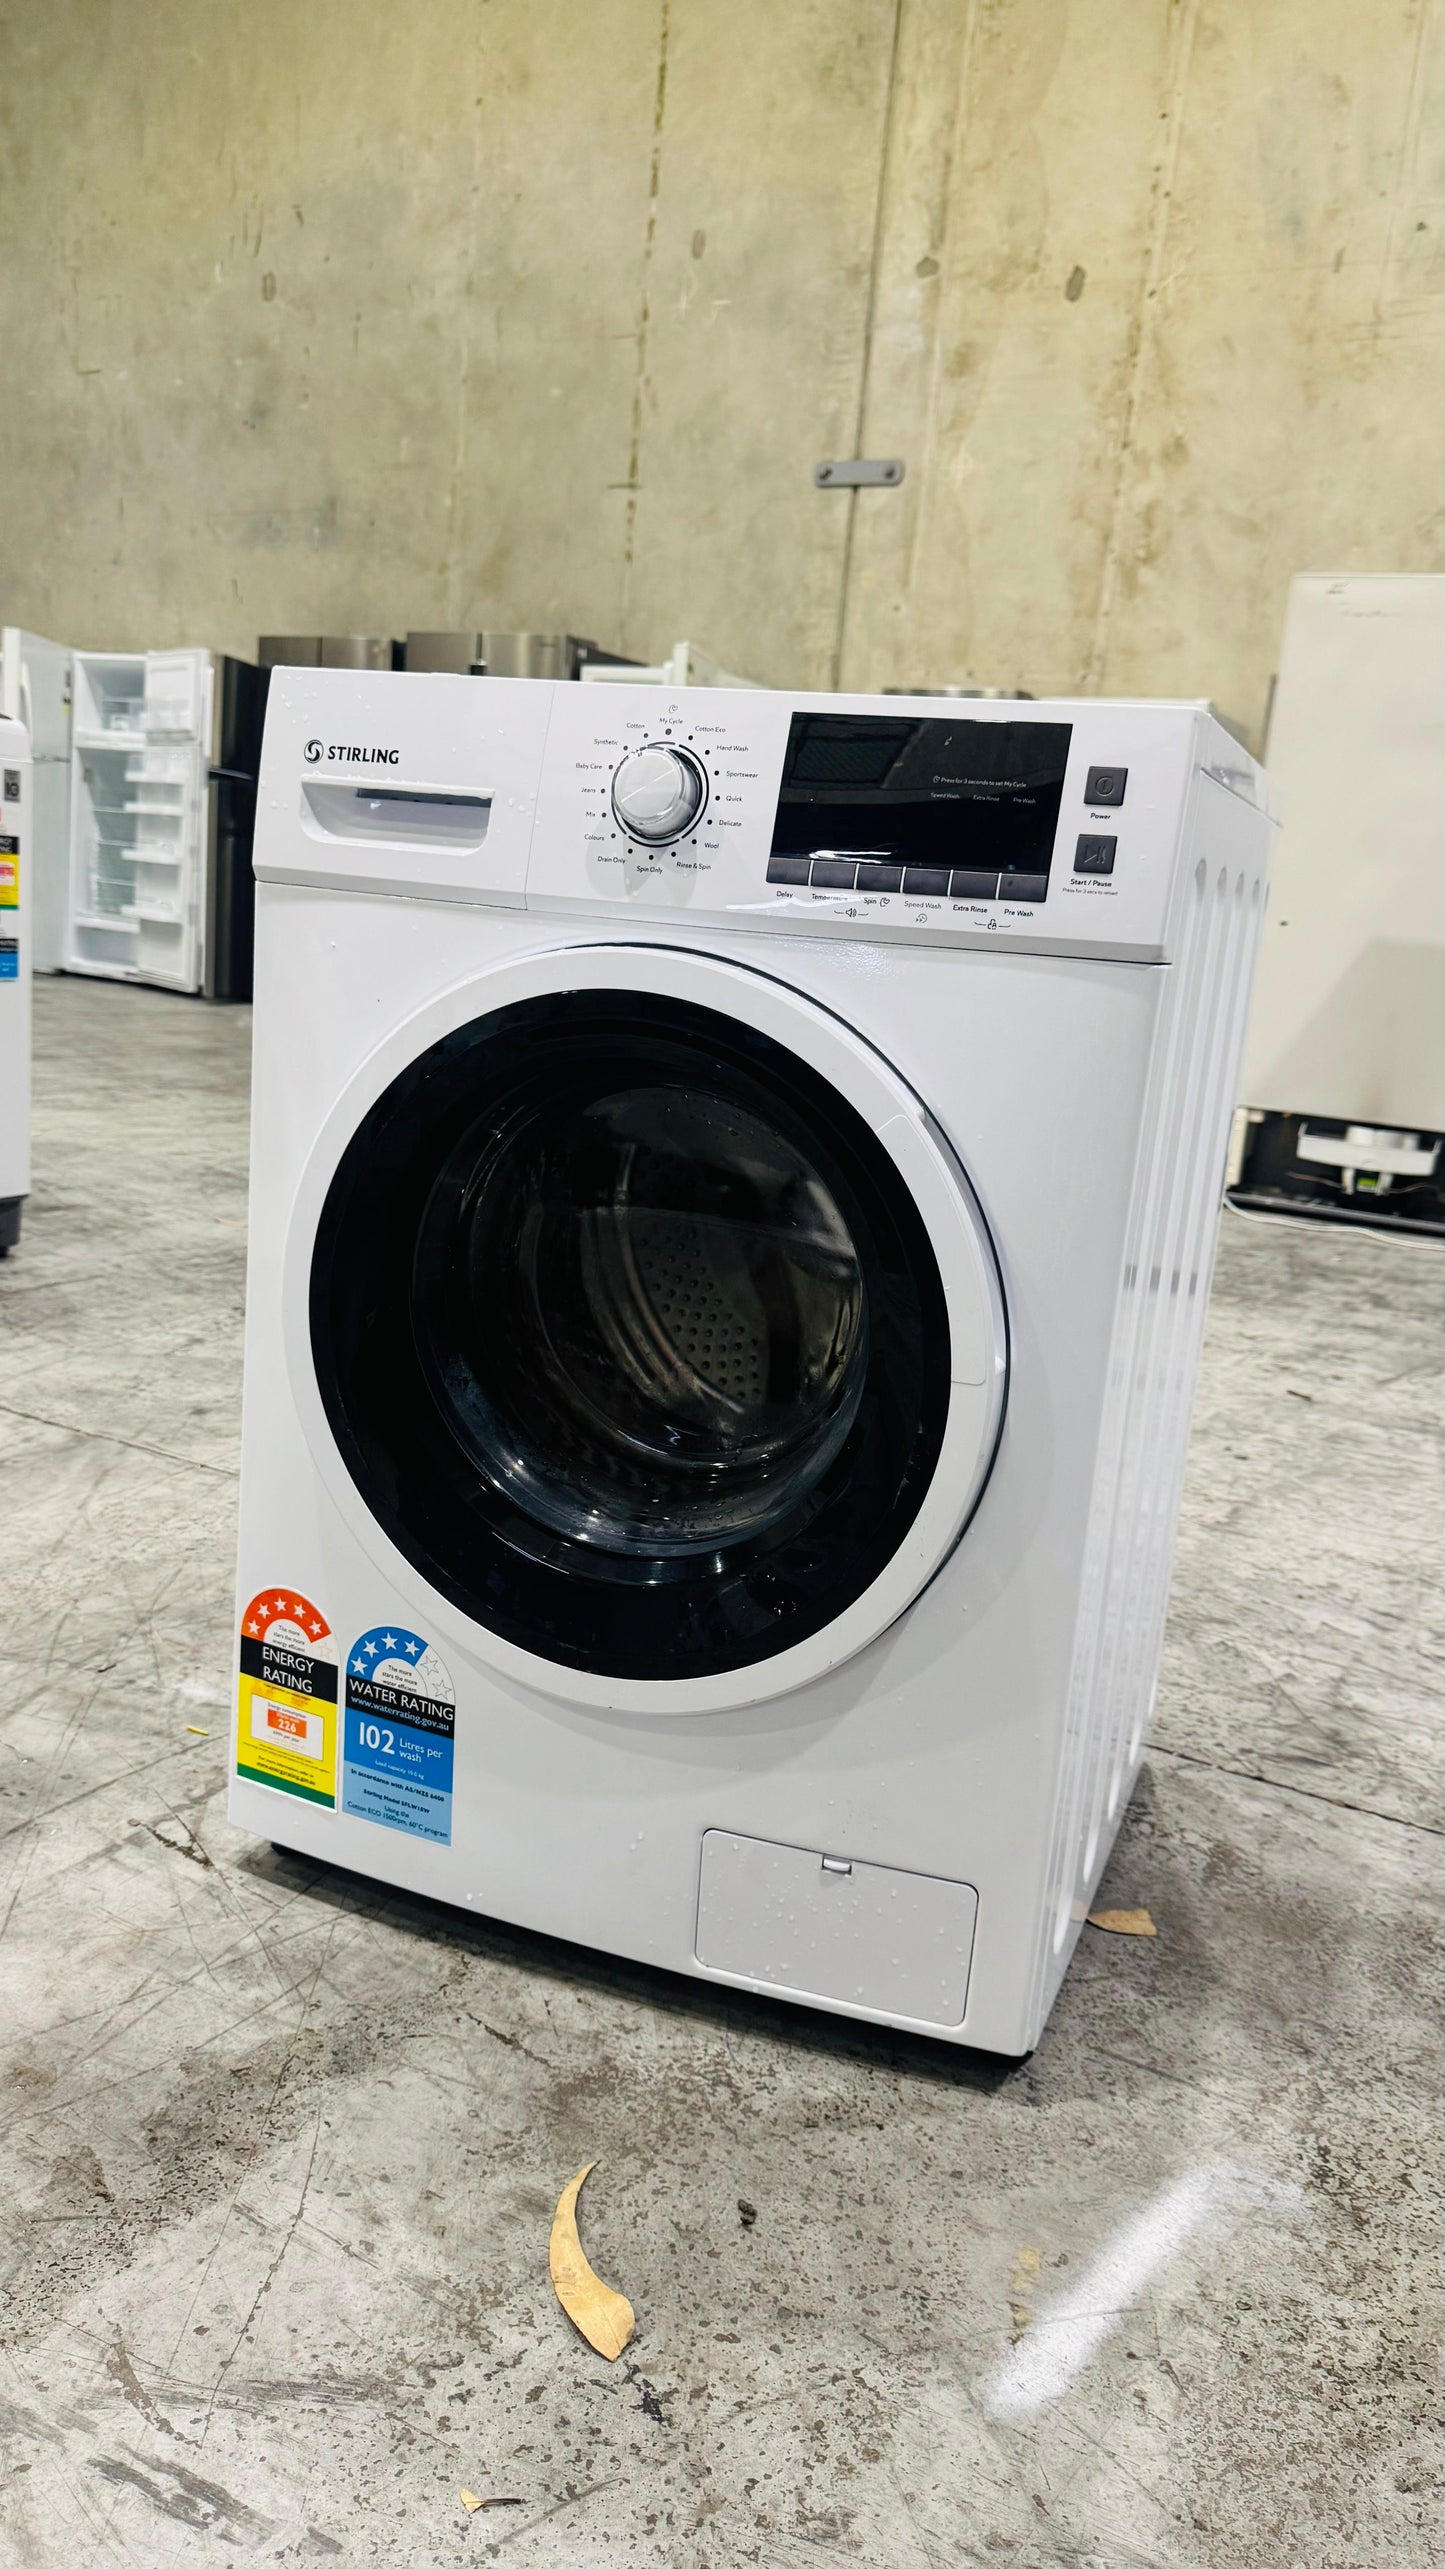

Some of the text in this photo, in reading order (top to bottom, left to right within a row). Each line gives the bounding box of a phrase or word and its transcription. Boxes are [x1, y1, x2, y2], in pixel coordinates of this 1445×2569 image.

[328, 746, 399, 764] STIRLING
[650, 866, 663, 874] Only
[776, 890, 794, 898] Delay
[904, 900, 924, 909] Speed
[262, 1646, 315, 1674] ENERGY
[263, 1666, 313, 1693] RATING
[404, 1678, 418, 1686] more
[397, 1683, 417, 1693] efficient
[350, 1679, 454, 1720] WATER RATING
[351, 1696, 449, 1731] www.waterrating.gov.au
[278, 1718, 297, 1733] 226
[359, 1722, 443, 1758] 102 Litres per
[399, 1750, 422, 1763] wash
[358, 1771, 389, 1785] accordance
[391, 1782, 404, 1790] with
[405, 1785, 428, 1798] AS/NZS
[430, 1794, 445, 1802] 6400
[363, 1789, 382, 1800] Stirling
[384, 1794, 400, 1805] Model
[384, 1805, 400, 1817] Using
[347, 1801, 367, 1812] Cotton
[368, 1808, 382, 1817] ECO
[409, 1820, 423, 1831] 60°C
[424, 1826, 448, 1838] program
